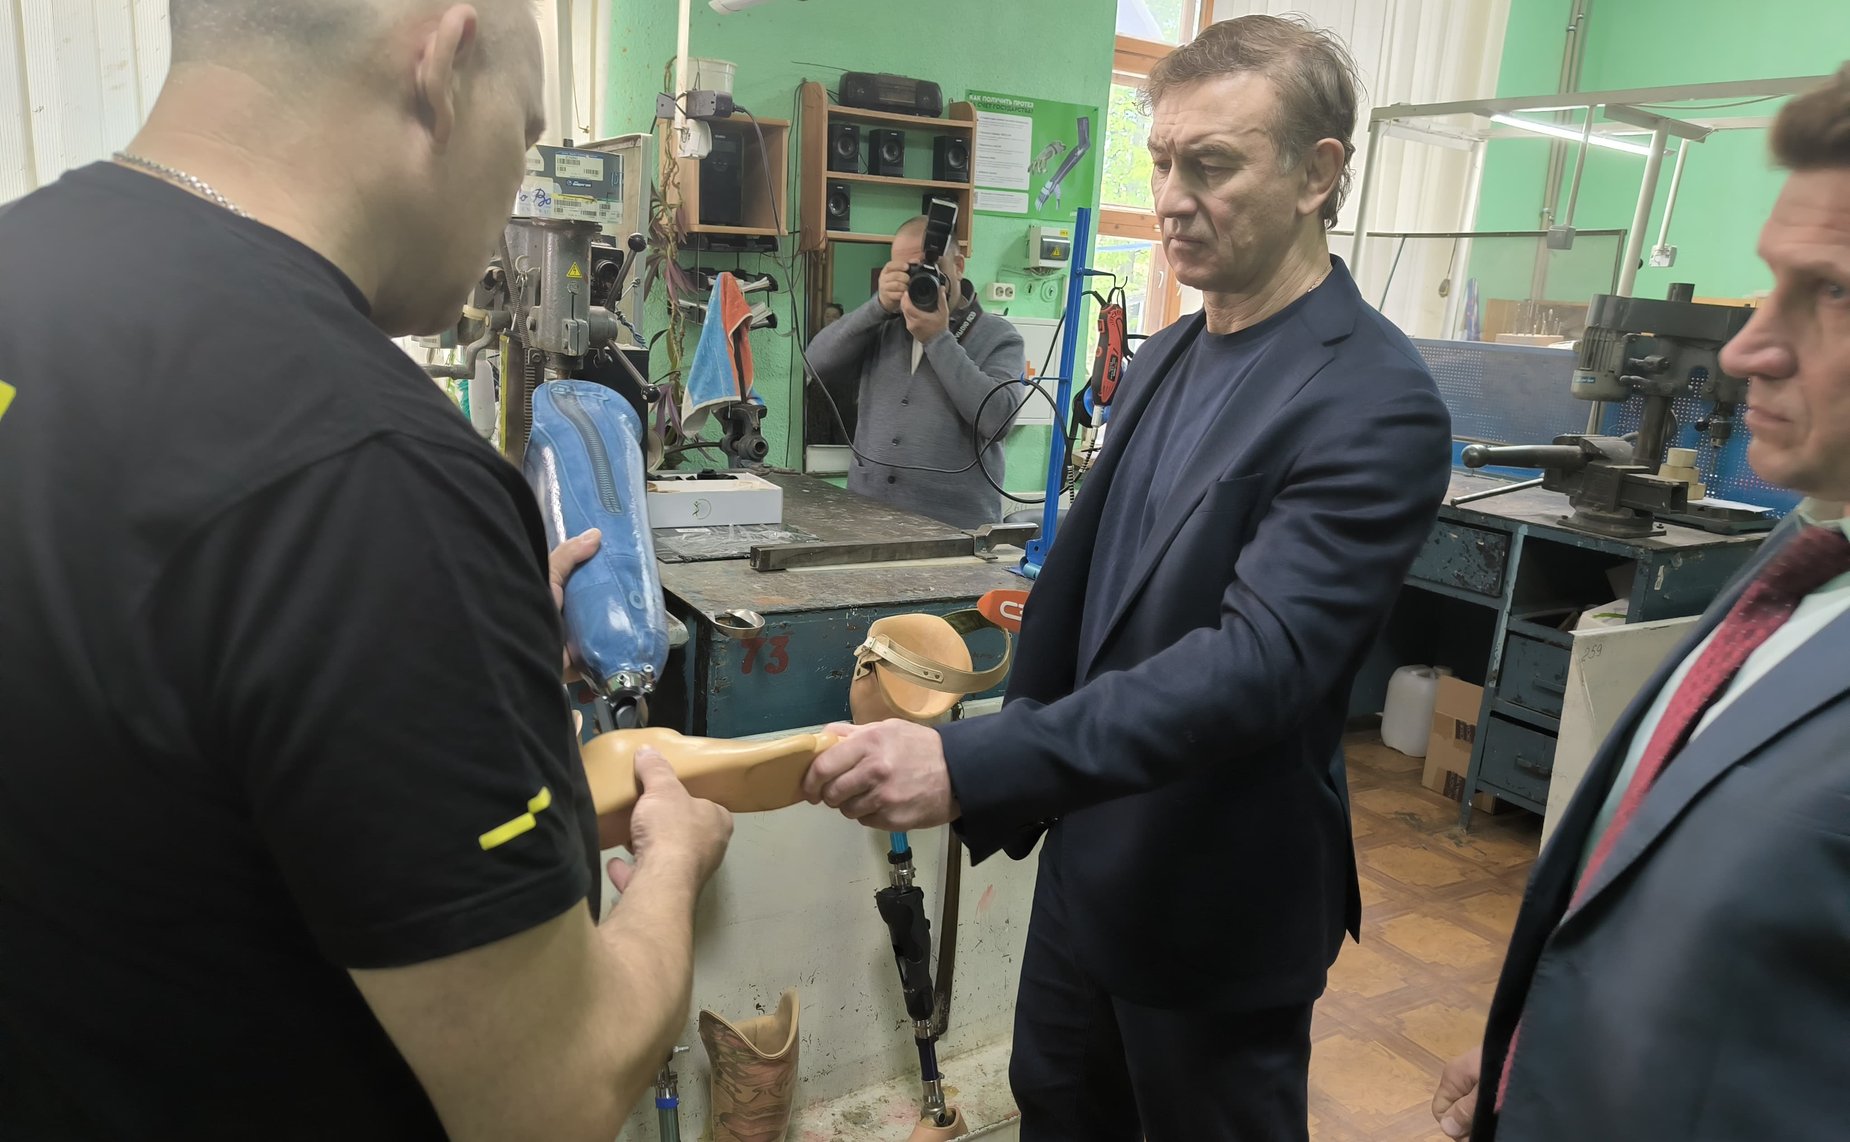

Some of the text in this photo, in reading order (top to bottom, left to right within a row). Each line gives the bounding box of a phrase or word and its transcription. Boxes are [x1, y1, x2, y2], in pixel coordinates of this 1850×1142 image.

[982, 96, 1012, 105] ПОЛУЧИТЬ
[1013, 100, 1033, 108] ПРОТЕЗ
[955, 321, 970, 338] DIGITA
[740, 635, 789, 674] 73
[1581, 643, 1603, 662] 259
